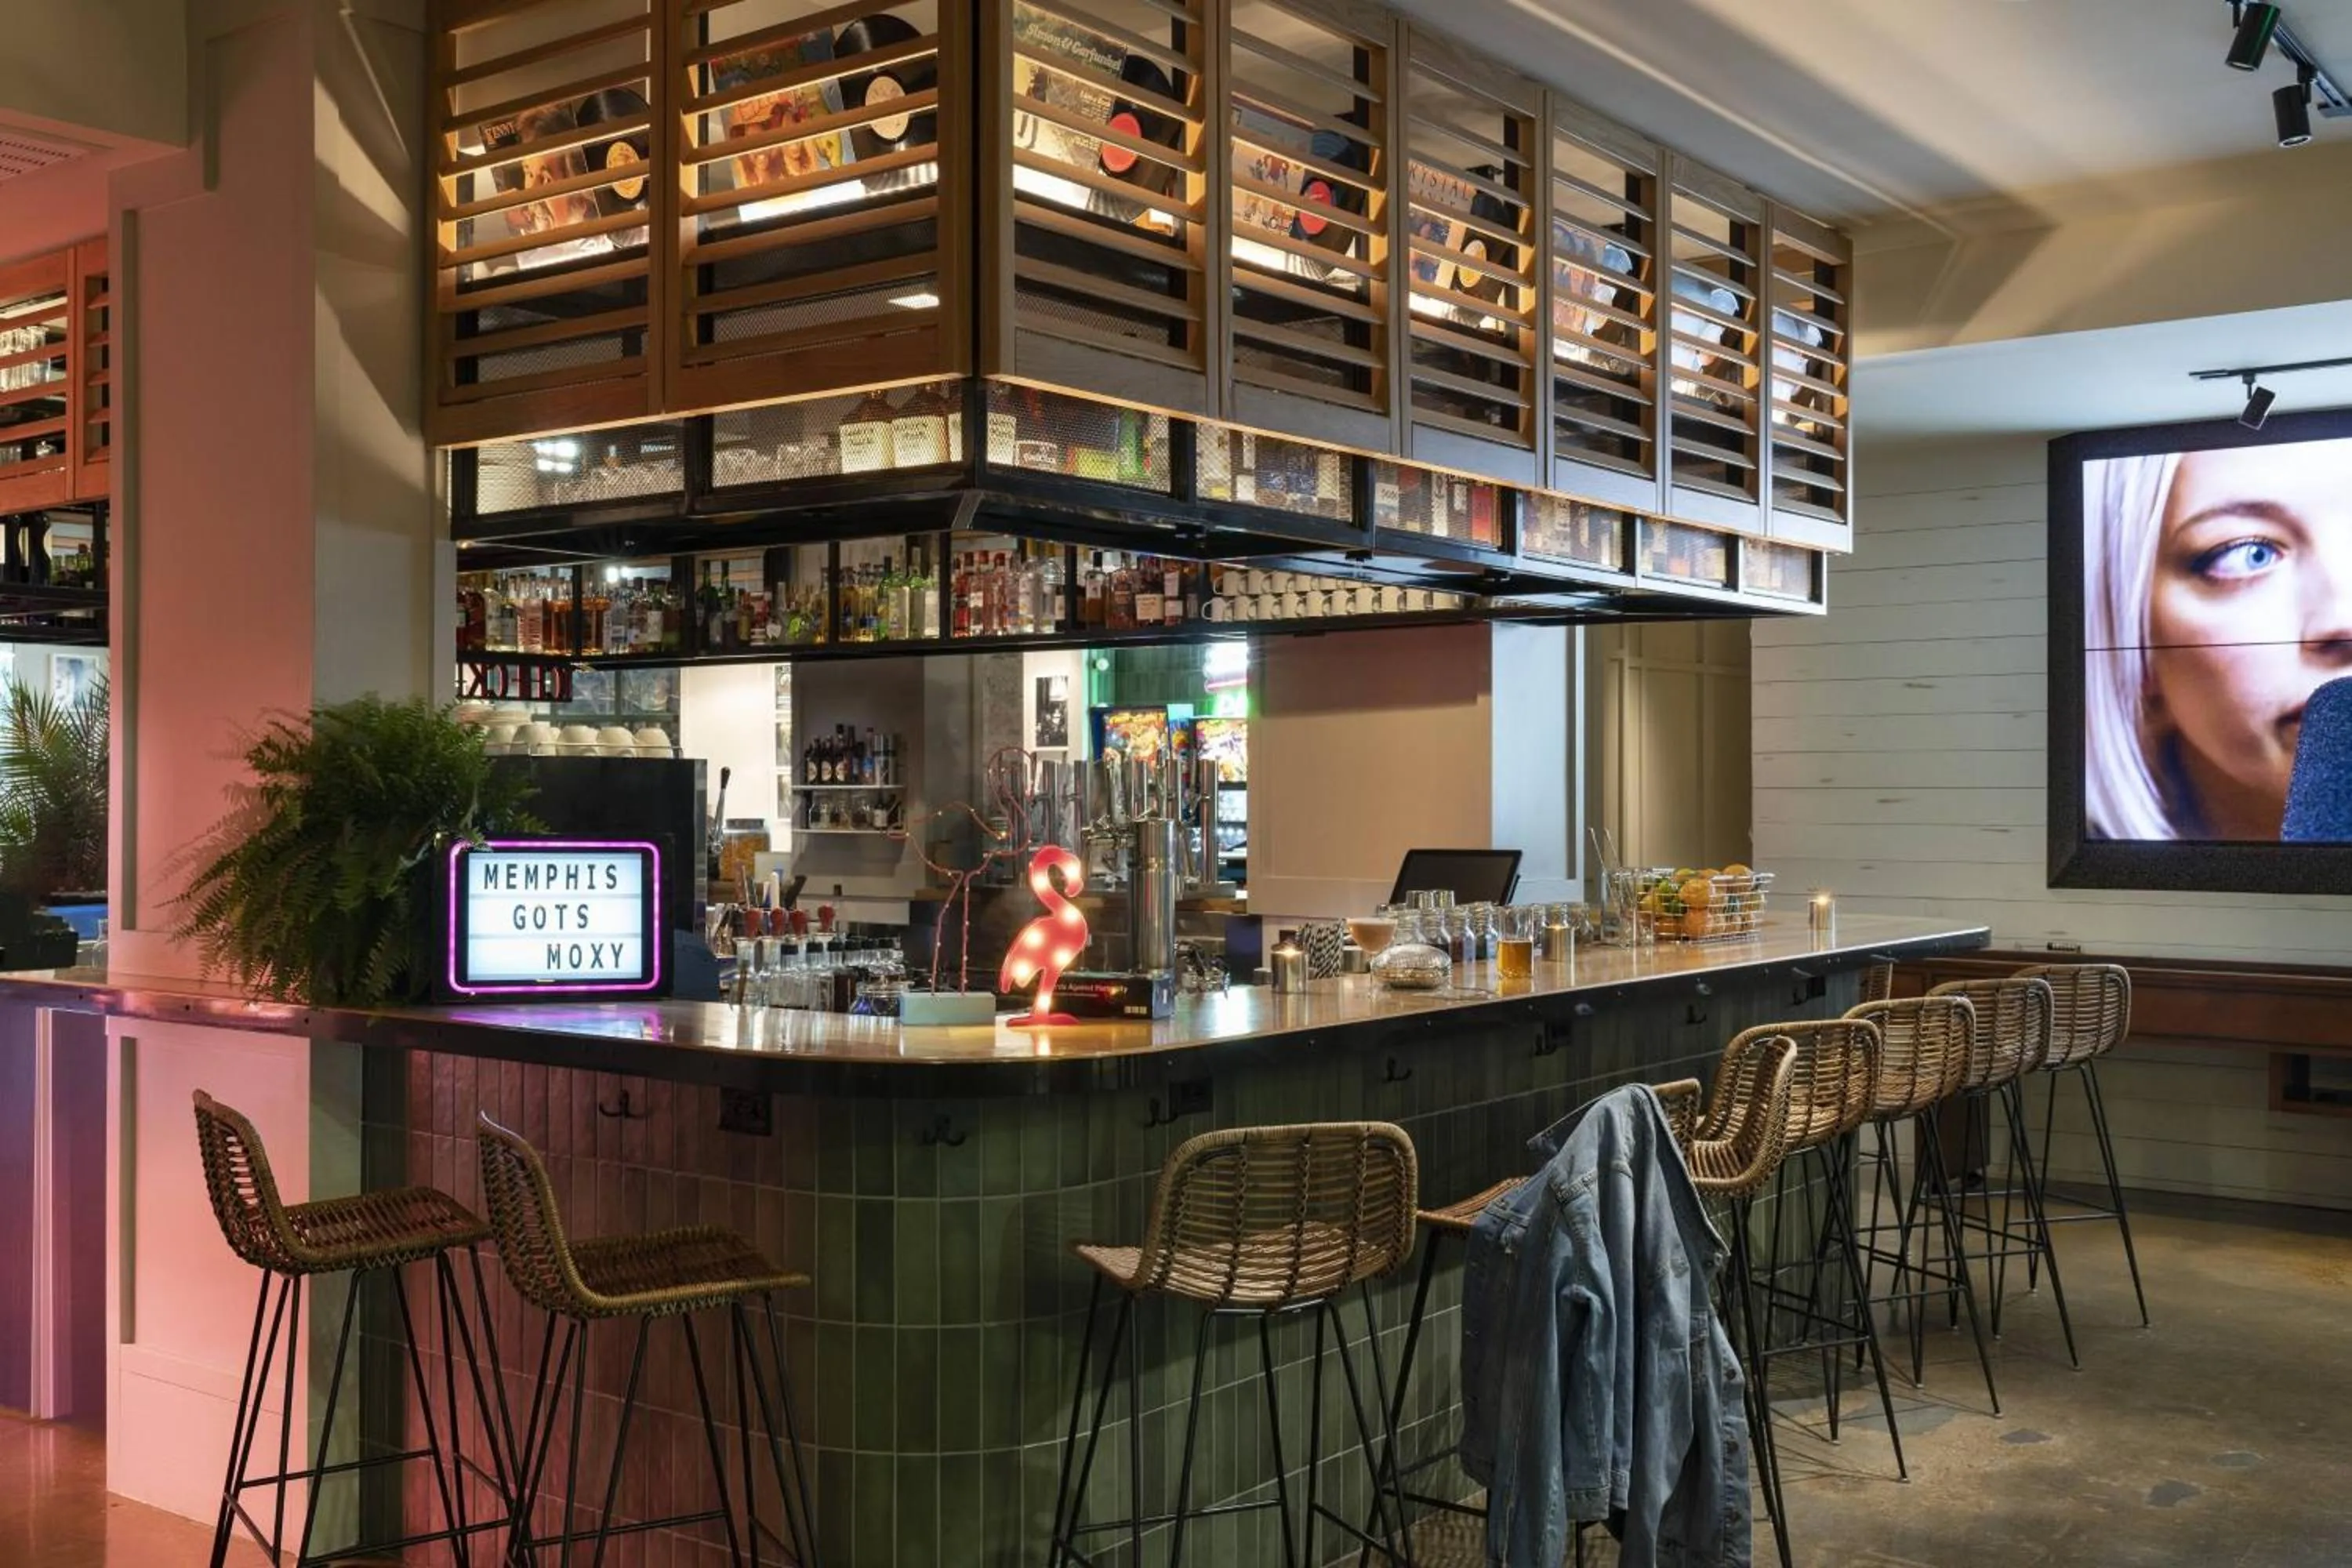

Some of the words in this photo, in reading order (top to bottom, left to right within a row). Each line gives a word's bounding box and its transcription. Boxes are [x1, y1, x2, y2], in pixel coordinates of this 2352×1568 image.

[1027, 24, 1061, 46] Simon
[1071, 42, 1122, 71] Garfunkel
[484, 863, 618, 891] MEMPHIS
[513, 904, 589, 930] GOTS
[546, 942, 623, 970] MOXY
